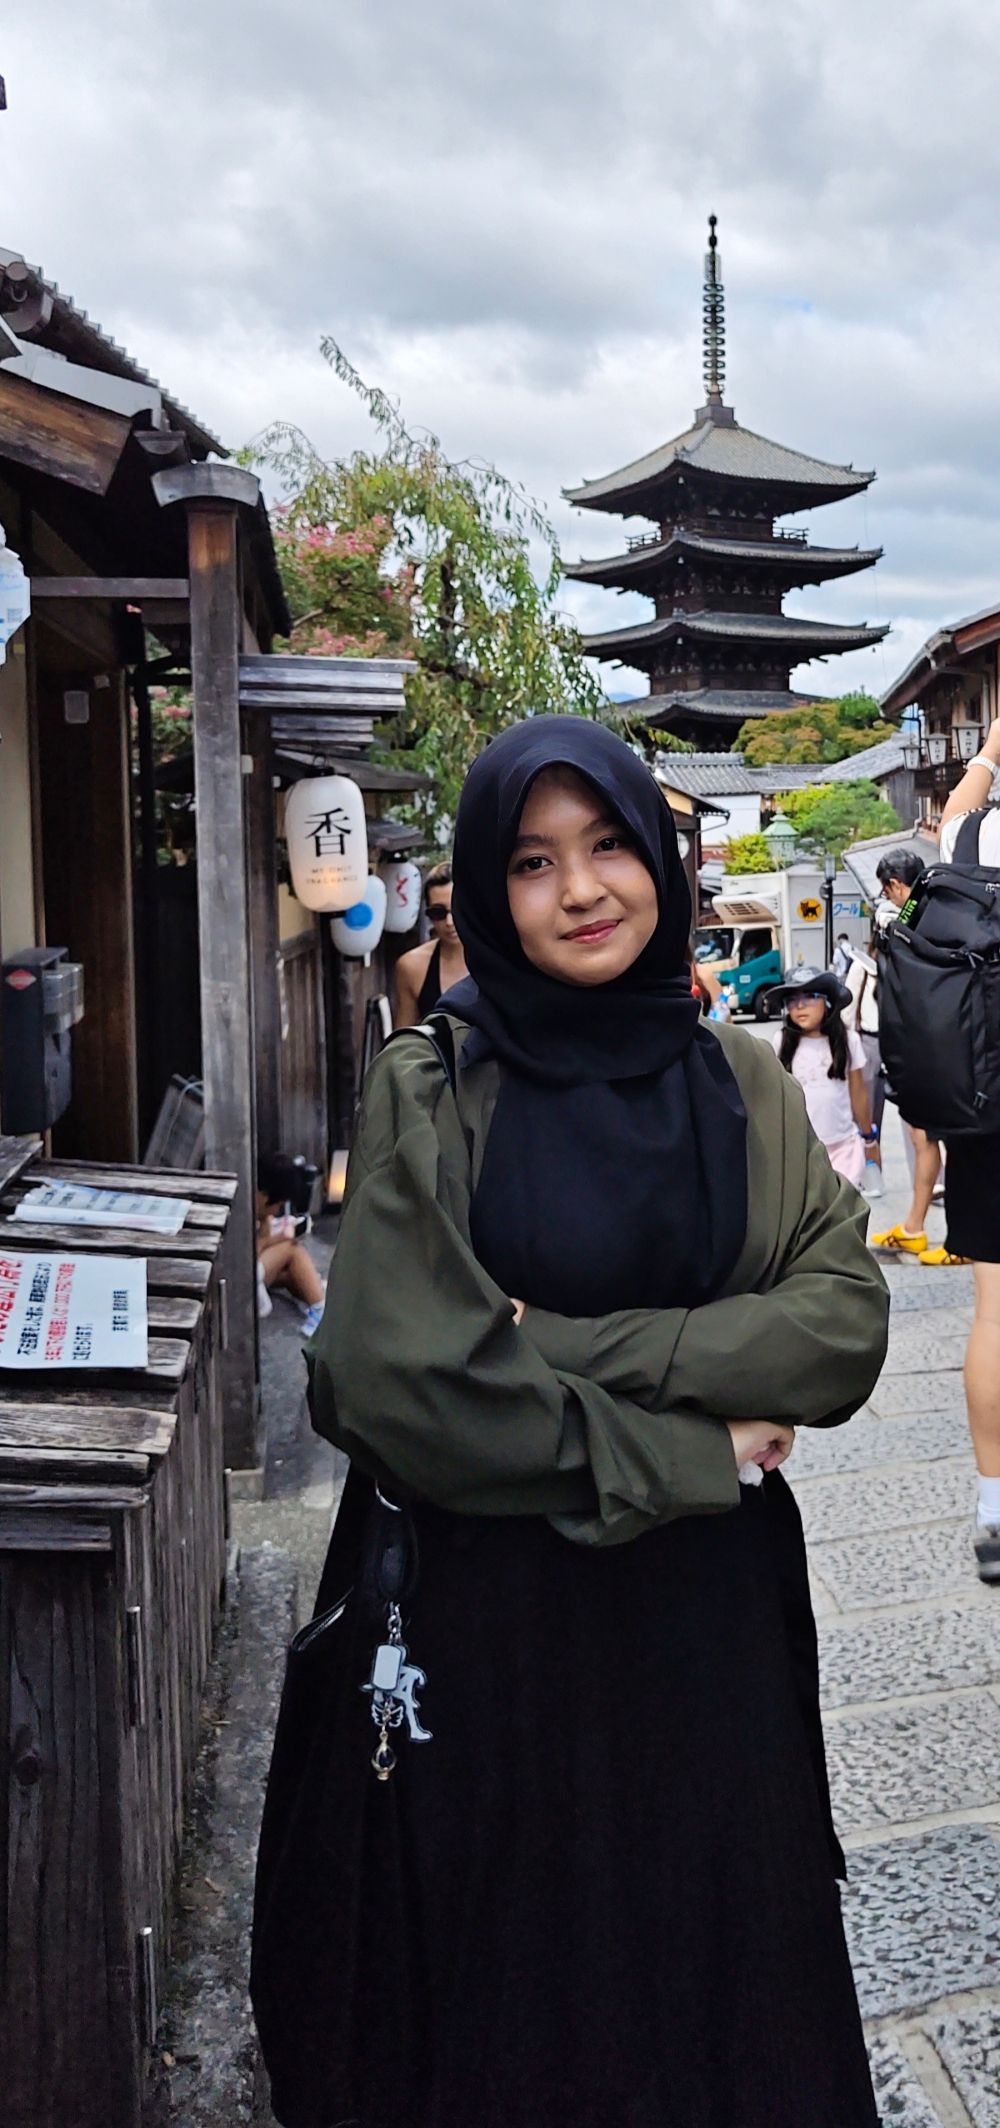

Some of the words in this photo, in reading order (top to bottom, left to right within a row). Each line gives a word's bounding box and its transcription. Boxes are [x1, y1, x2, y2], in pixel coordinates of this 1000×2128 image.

[304, 807, 352, 857] 香
[833, 902, 858, 916] クール
